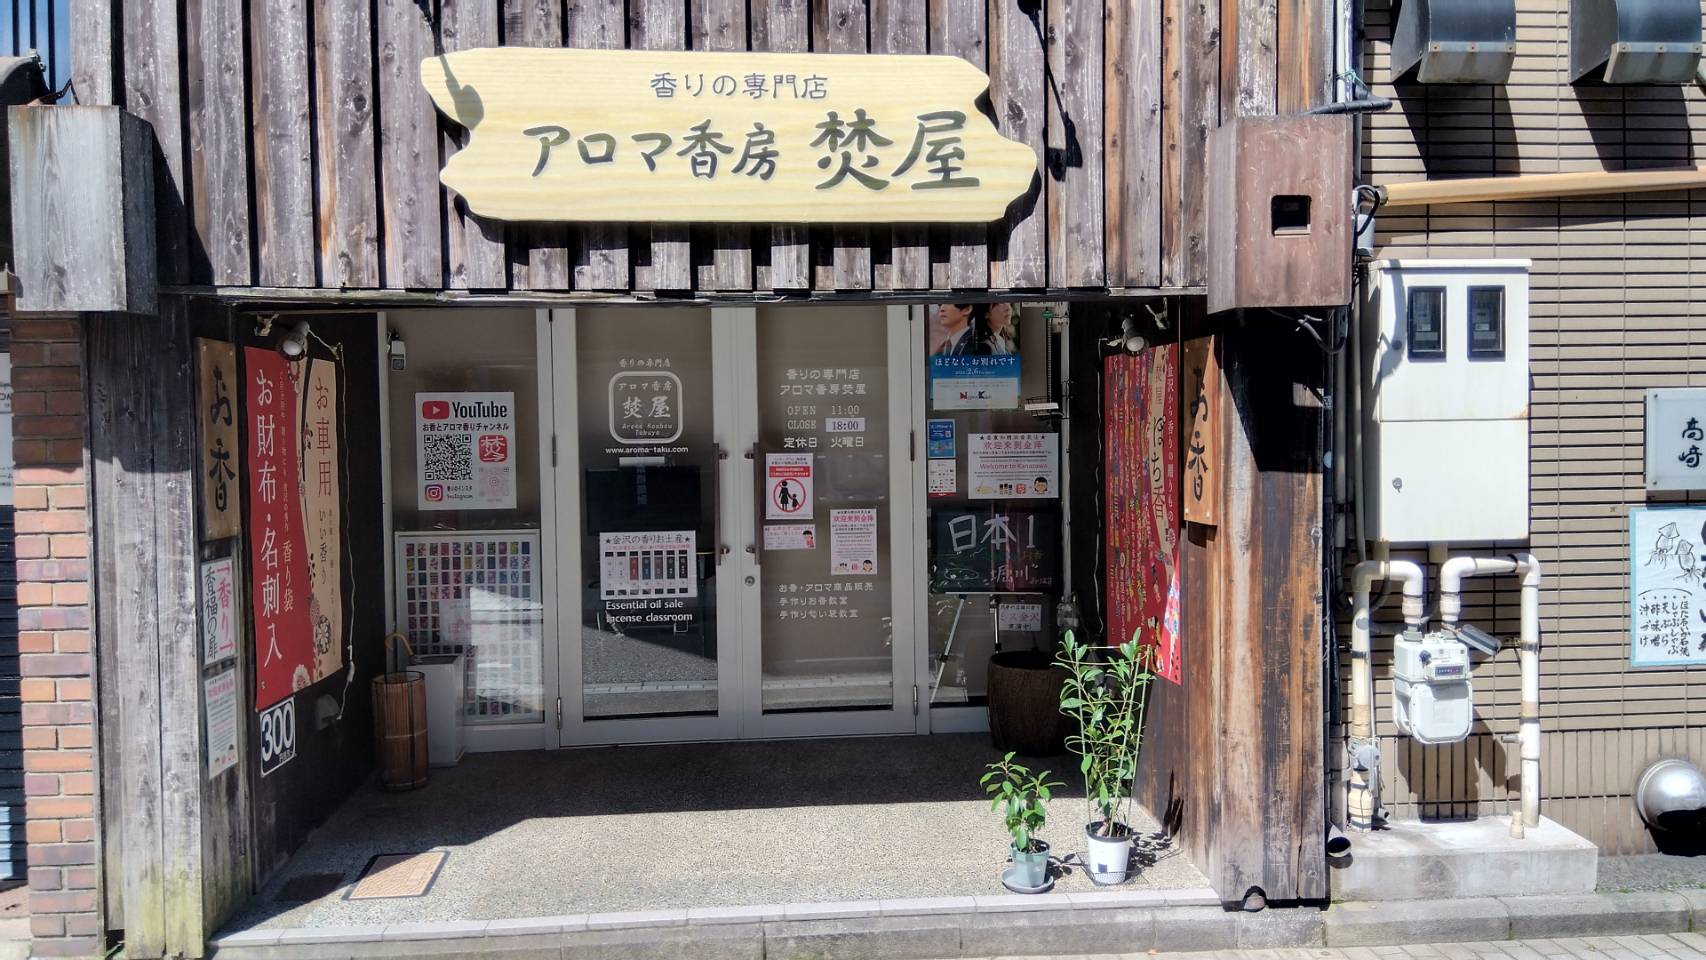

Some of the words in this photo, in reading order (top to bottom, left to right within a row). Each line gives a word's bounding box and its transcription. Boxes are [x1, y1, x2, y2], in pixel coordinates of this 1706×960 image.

[650, 72, 829, 99] 香りの専門店
[523, 118, 782, 181] アロマ香房
[809, 109, 981, 190] 焚屋
[619, 358, 671, 368] 香りの専門店
[935, 357, 1016, 367] ほどなく、お別れです
[786, 369, 860, 380] 香りの専門店
[618, 380, 672, 391] アロマ香房
[780, 383, 867, 395] アロマ香房焚屋
[452, 401, 508, 418] YouTube
[622, 395, 671, 419] 焚屋
[787, 406, 816, 415] OPEN
[831, 405, 860, 415] 11:00
[422, 423, 509, 432] お香とアロマ香りチャンネル
[787, 420, 816, 430] CLOSE
[832, 421, 859, 430] 18:00
[316, 377, 332, 497] お車用
[1187, 366, 1209, 502] お香
[784, 437, 817, 448] 定休日
[831, 436, 864, 448] 火曜日
[605, 446, 689, 454] www.aroma-taku.com
[257, 369, 282, 668] お財布・名刺入
[605, 600, 647, 610] Essential
[650, 600, 661, 609] oil
[664, 599, 684, 608] sale
[646, 612, 693, 622] classroom
[262, 702, 293, 762] 300
